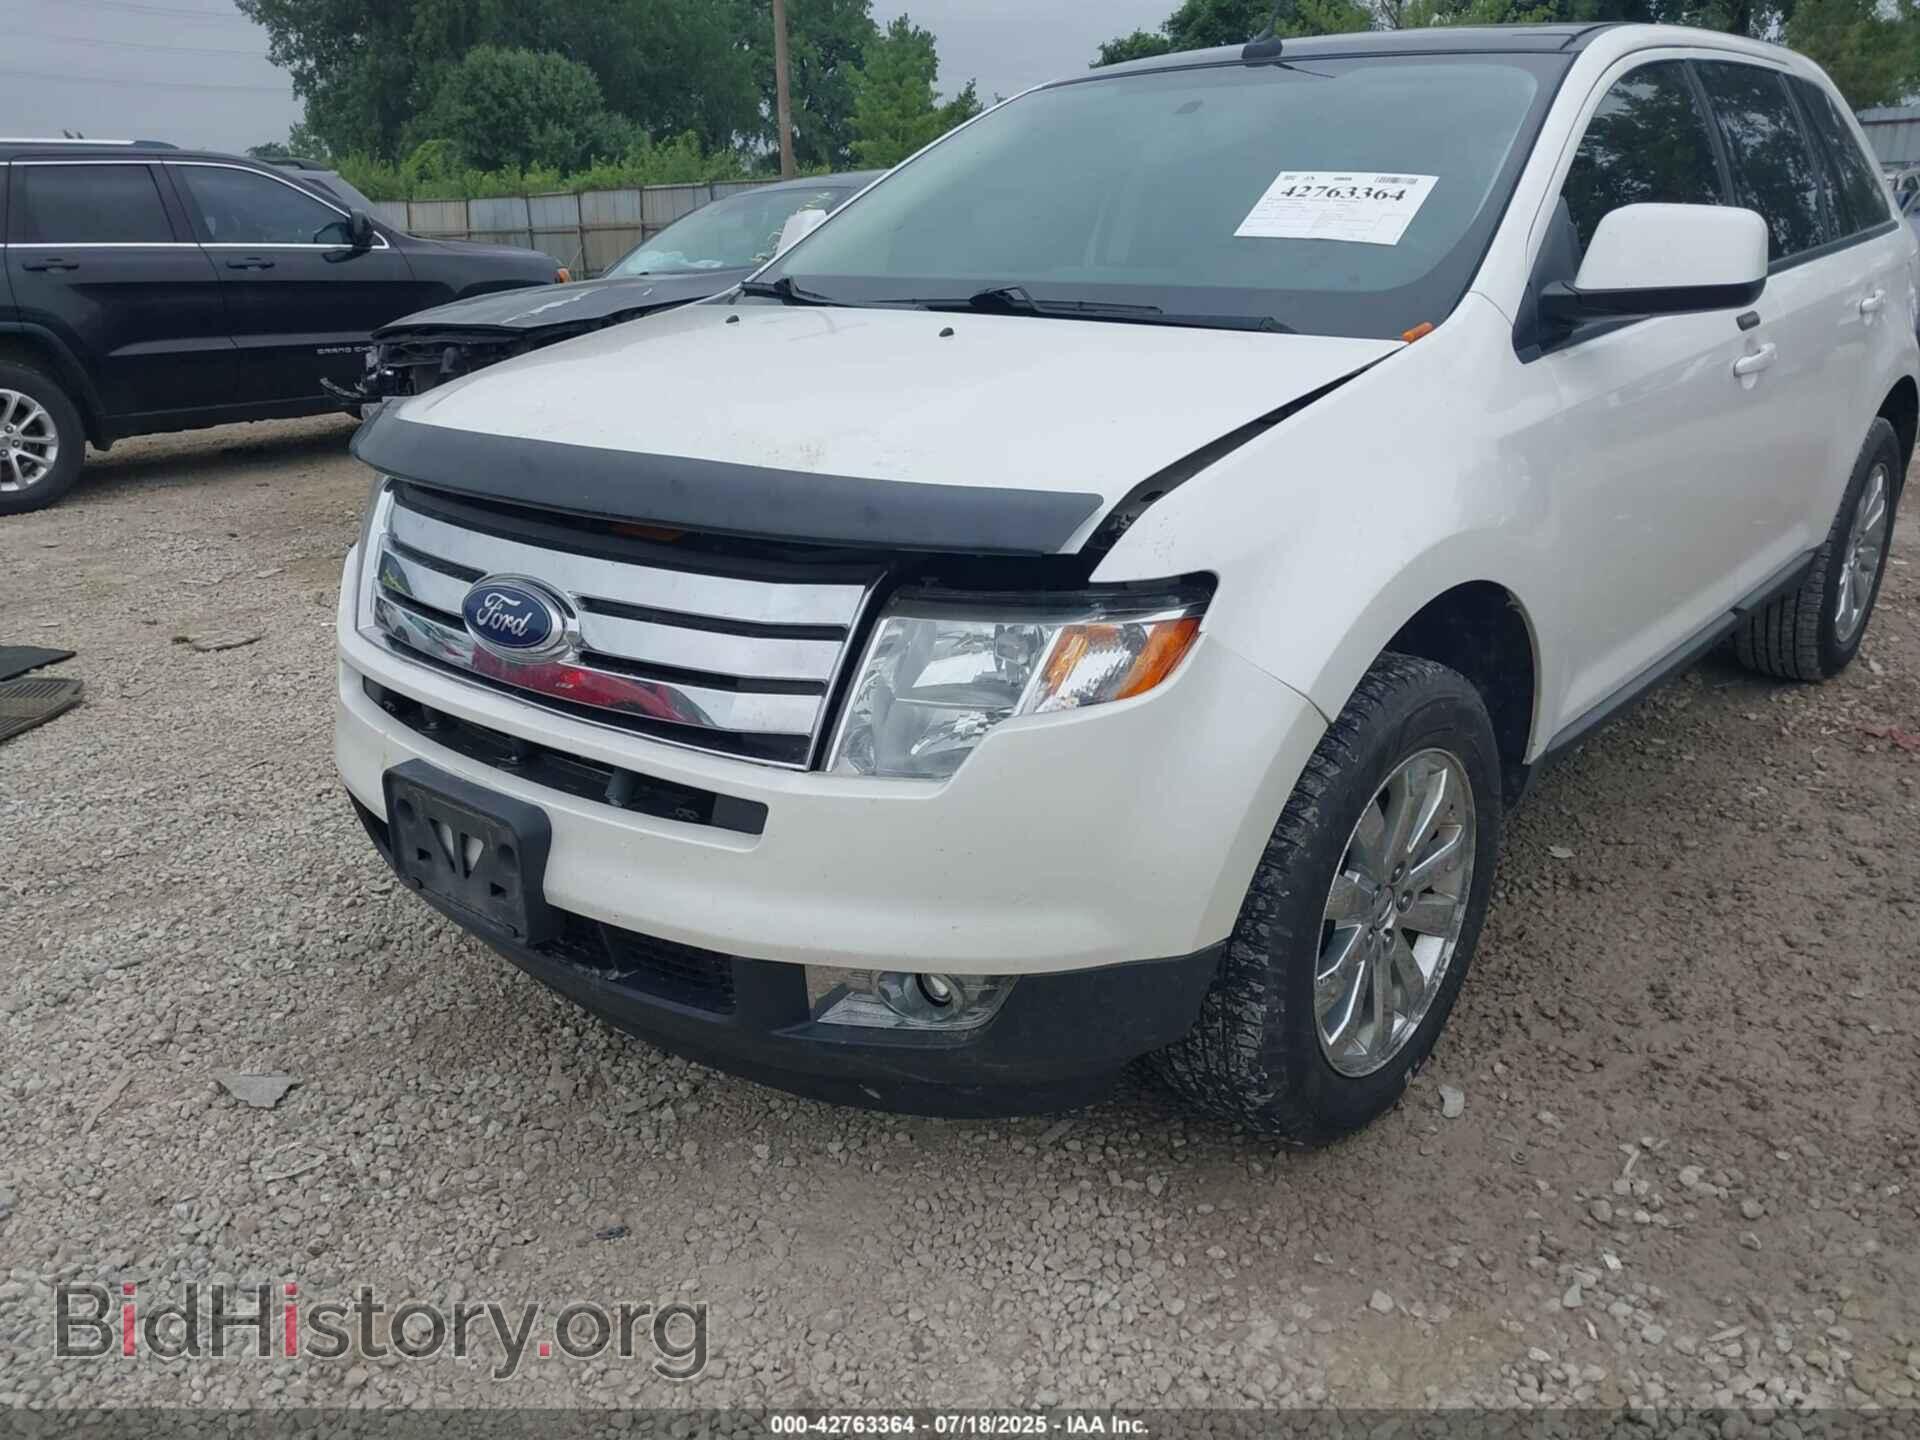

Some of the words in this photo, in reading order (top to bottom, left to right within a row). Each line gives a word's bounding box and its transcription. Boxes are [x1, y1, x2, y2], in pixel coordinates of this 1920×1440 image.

[1280, 185, 1407, 201] 42763364
[316, 346, 352, 355] GRAND
[476, 592, 533, 636] Ford
